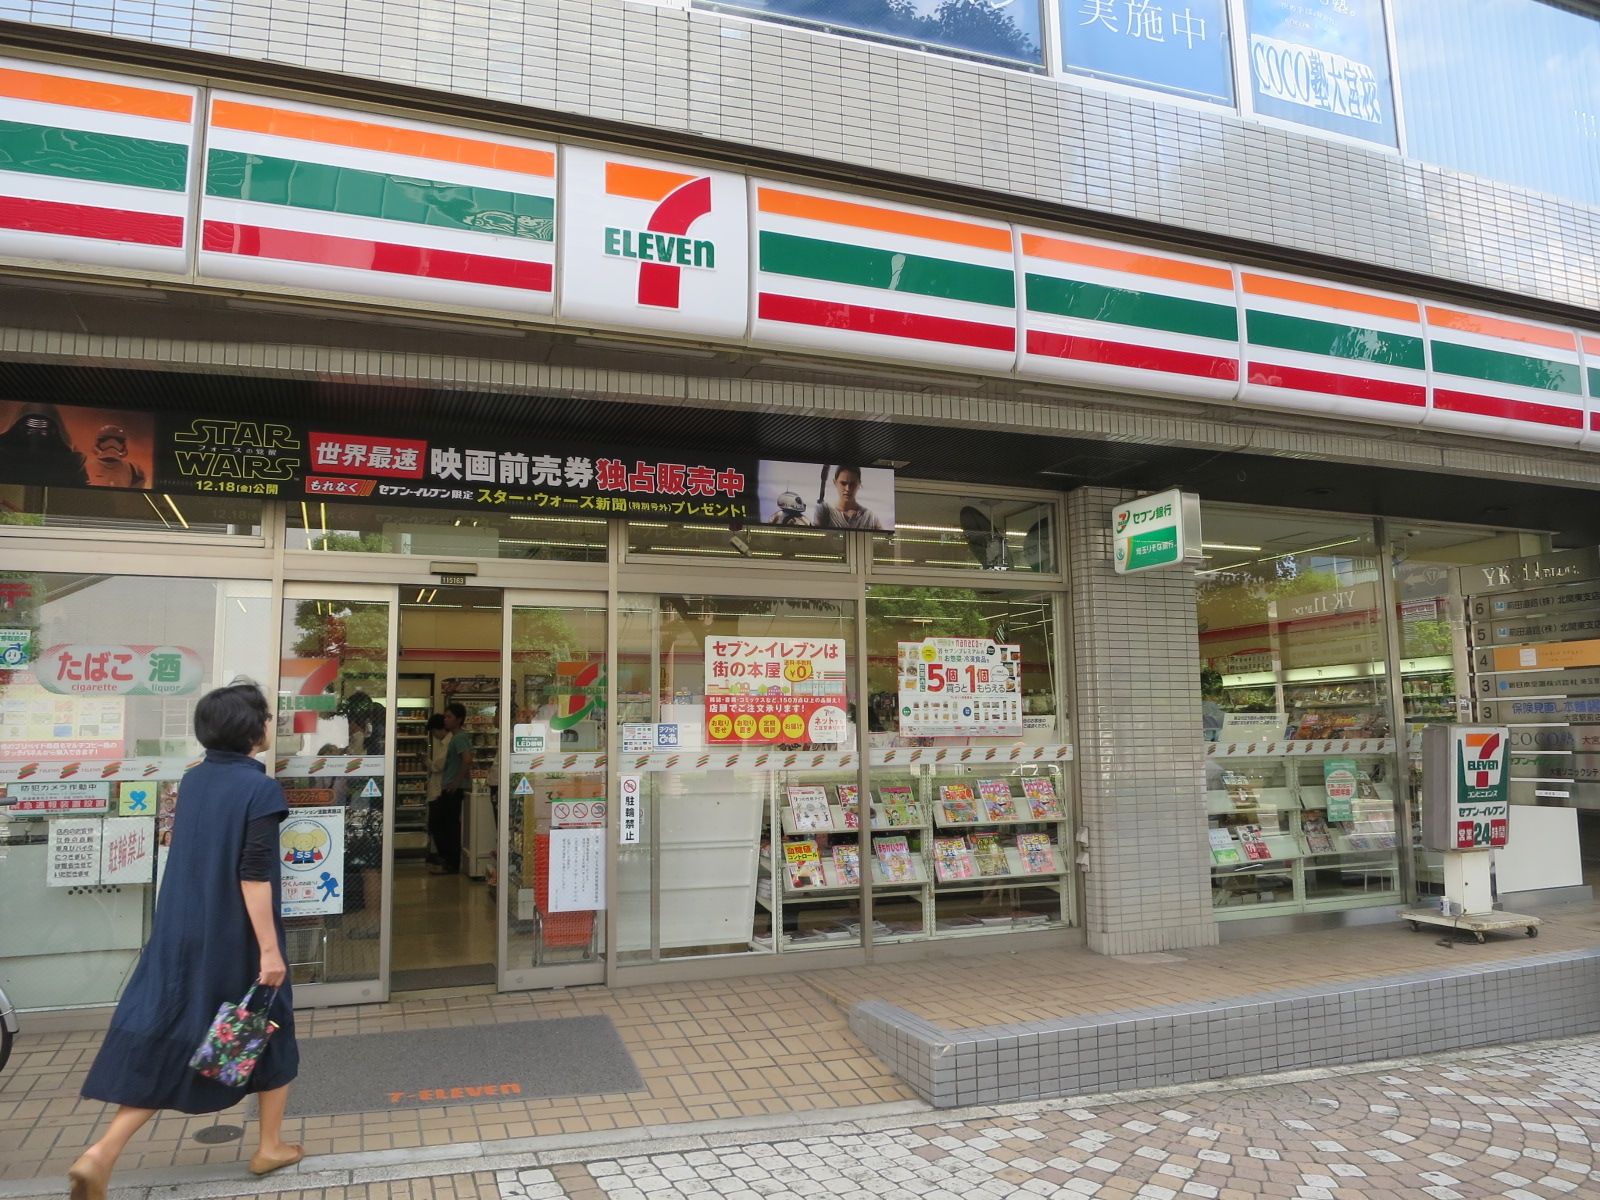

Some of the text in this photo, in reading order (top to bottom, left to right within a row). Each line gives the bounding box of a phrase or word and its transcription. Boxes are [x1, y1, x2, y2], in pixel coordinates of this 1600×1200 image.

[605, 160, 712, 309] 7
[175, 419, 300, 449] STAR
[317, 441, 419, 471] 世界最速
[175, 451, 300, 480] WARS
[310, 480, 358, 493] もれなく
[1133, 504, 1172, 525] セブン銀行
[1475, 603, 1484, 615] 6
[1477, 629, 1486, 641] 5
[57, 651, 182, 682] たばこ 酒
[1479, 654, 1488, 666] 4
[713, 661, 781, 678] 街の本屋
[71, 684, 181, 692] cigarette liquor
[977, 684, 1006, 693] もらえる
[1481, 680, 1490, 692] 3
[1483, 707, 1492, 718] 3
[21, 784, 97, 792] 防犯カメラ作動中
[624, 796, 635, 841] 駐輪禁止
[1474, 822, 1491, 845] 24
[1491, 825, 1506, 839] 時間
[788, 853, 818, 861] コントロール
